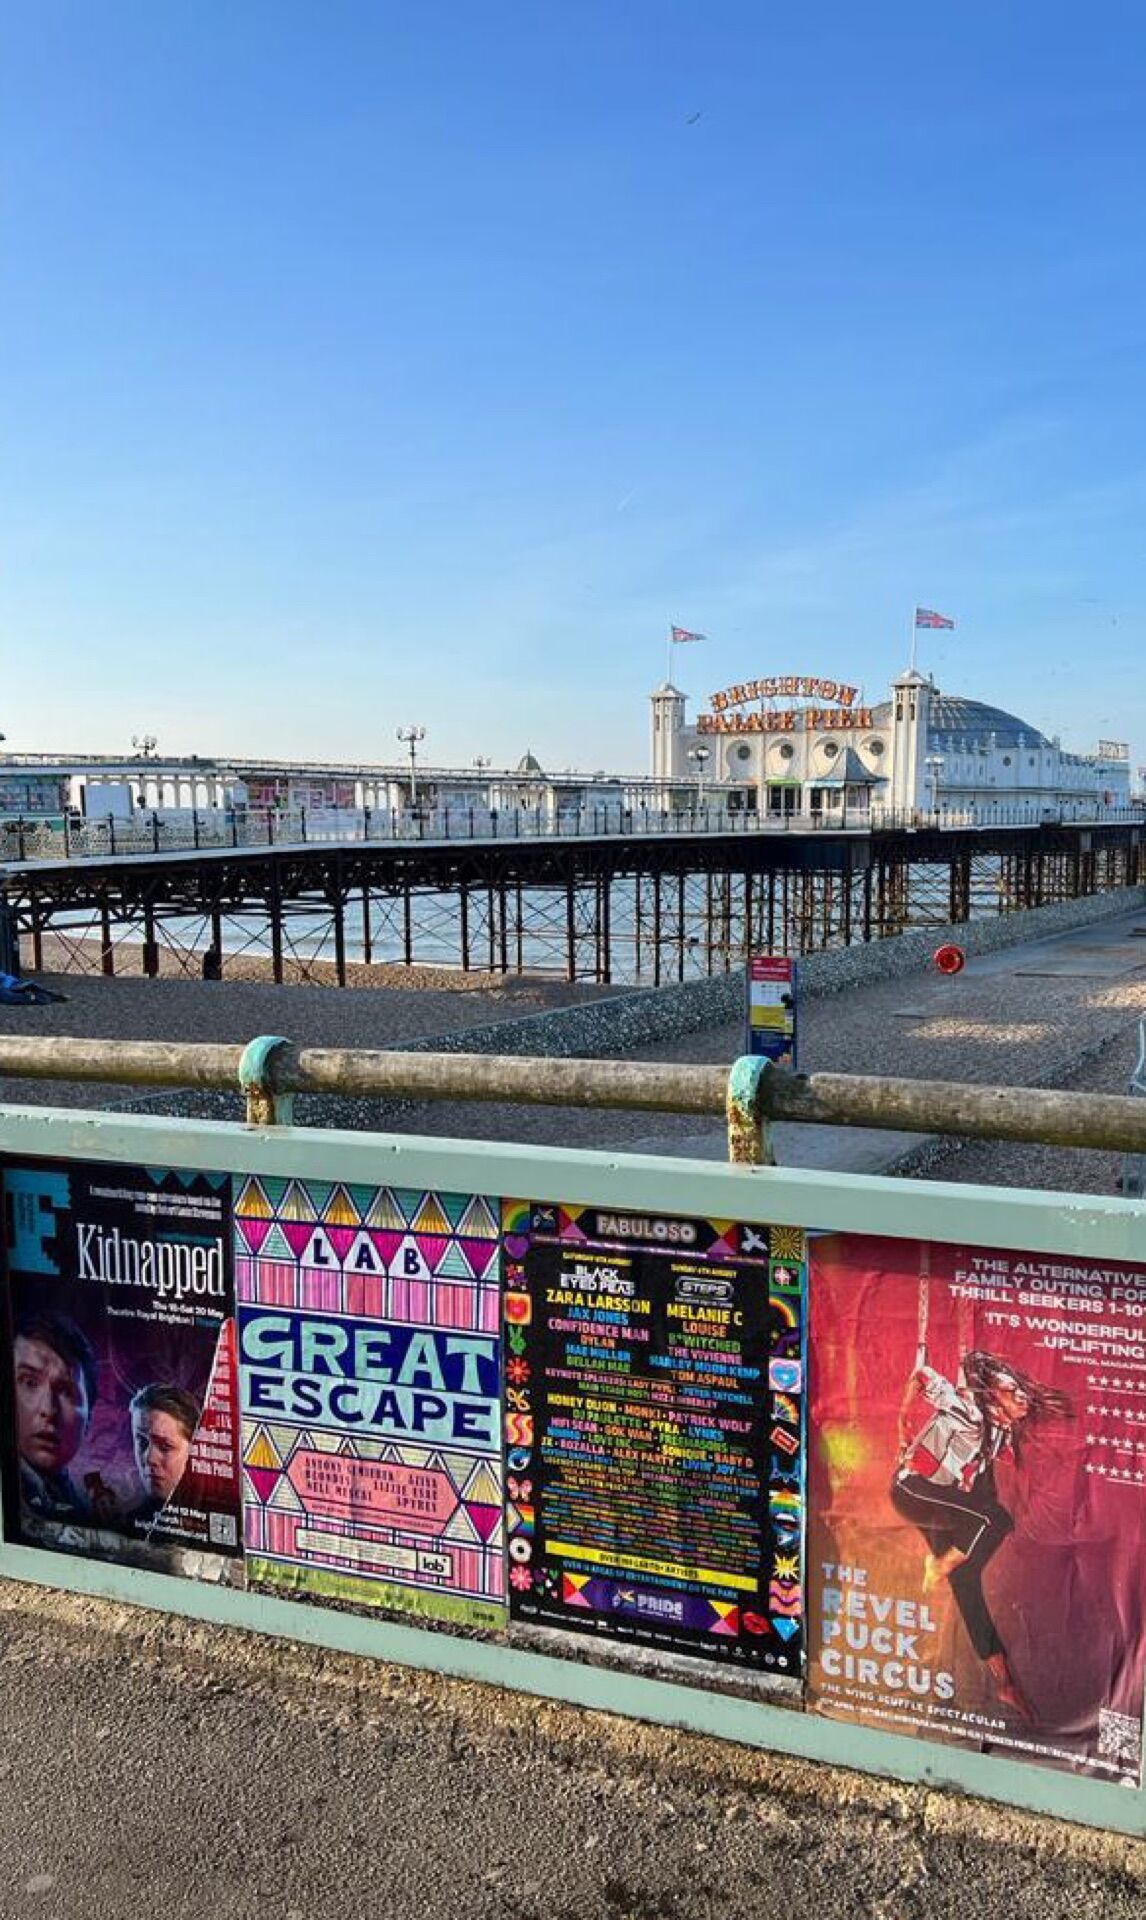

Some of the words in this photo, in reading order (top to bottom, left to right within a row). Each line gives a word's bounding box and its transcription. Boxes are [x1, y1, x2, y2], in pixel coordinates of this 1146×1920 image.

[710, 676, 858, 712] BRIGHTON
[697, 712, 796, 734] PALACE
[805, 707, 873, 730] PIER
[596, 1214, 696, 1243] FABULOSO
[76, 1223, 226, 1298] Kidnapped
[313, 1239, 421, 1275] LAB
[560, 1273, 597, 1290] EYED
[599, 1278, 635, 1295] PEAS
[575, 1265, 618, 1280] BLACK
[955, 1271, 1023, 1289] FAMILY
[971, 1257, 1010, 1273] THE
[1014, 1262, 1146, 1287] ALTERNATIVE
[682, 1281, 727, 1296] STEPS
[948, 1283, 1013, 1303] THRILL
[1018, 1291, 1103, 1314] SEEKERS
[546, 1289, 585, 1306] ZARA
[587, 1294, 650, 1314] LARSSON
[568, 1306, 589, 1320] JAX
[593, 1310, 629, 1326] JONES
[667, 1303, 731, 1324] MELANIE
[734, 1311, 743, 1326] C
[548, 1318, 618, 1338] CONFIDENCE
[621, 1326, 649, 1341] MAN
[580, 1334, 615, 1348] DYLAN
[682, 1321, 727, 1338] LOUISE
[1025, 1316, 1146, 1342] WONDERFUL
[242, 1316, 494, 1394] GREAT
[668, 1346, 689, 1359] THE
[670, 1370, 695, 1382] TOM
[697, 1374, 739, 1389] ASPAUL
[730, 1366, 760, 1380] KEMP
[249, 1373, 492, 1441] ESCAPE
[547, 1393, 583, 1407] HONEY
[668, 1411, 716, 1427] PATRICK
[718, 1419, 752, 1433] WOLF
[822, 1562, 867, 1587] THE
[637, 1593, 683, 1615] PRIDE
[822, 1586, 936, 1632] REVEL
[822, 1619, 919, 1660] PUCK
[821, 1648, 954, 1698] CIRCUS
[822, 1683, 840, 1694] THE
[928, 1705, 1006, 1730] SPECTACULAR
